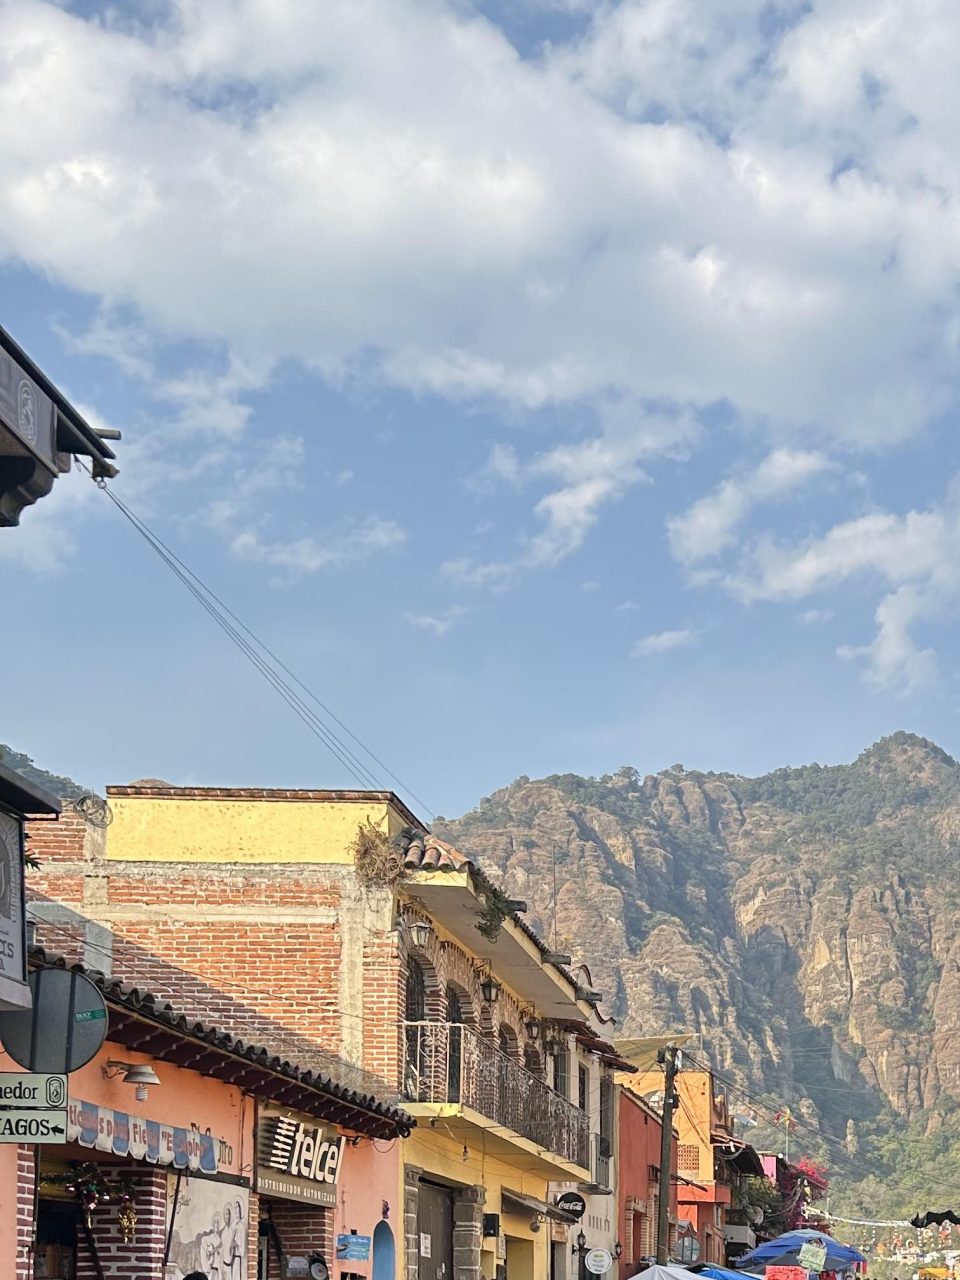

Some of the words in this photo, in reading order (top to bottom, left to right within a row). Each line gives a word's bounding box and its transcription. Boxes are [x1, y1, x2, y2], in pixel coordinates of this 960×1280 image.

[0, 1081, 39, 1100] edor
[0, 1118, 51, 1137] AGOS
[291, 1122, 347, 1185] telcel
[257, 1177, 302, 1196] DISTRIBUIDOR
[303, 1187, 337, 1204] AUTORIZADO
